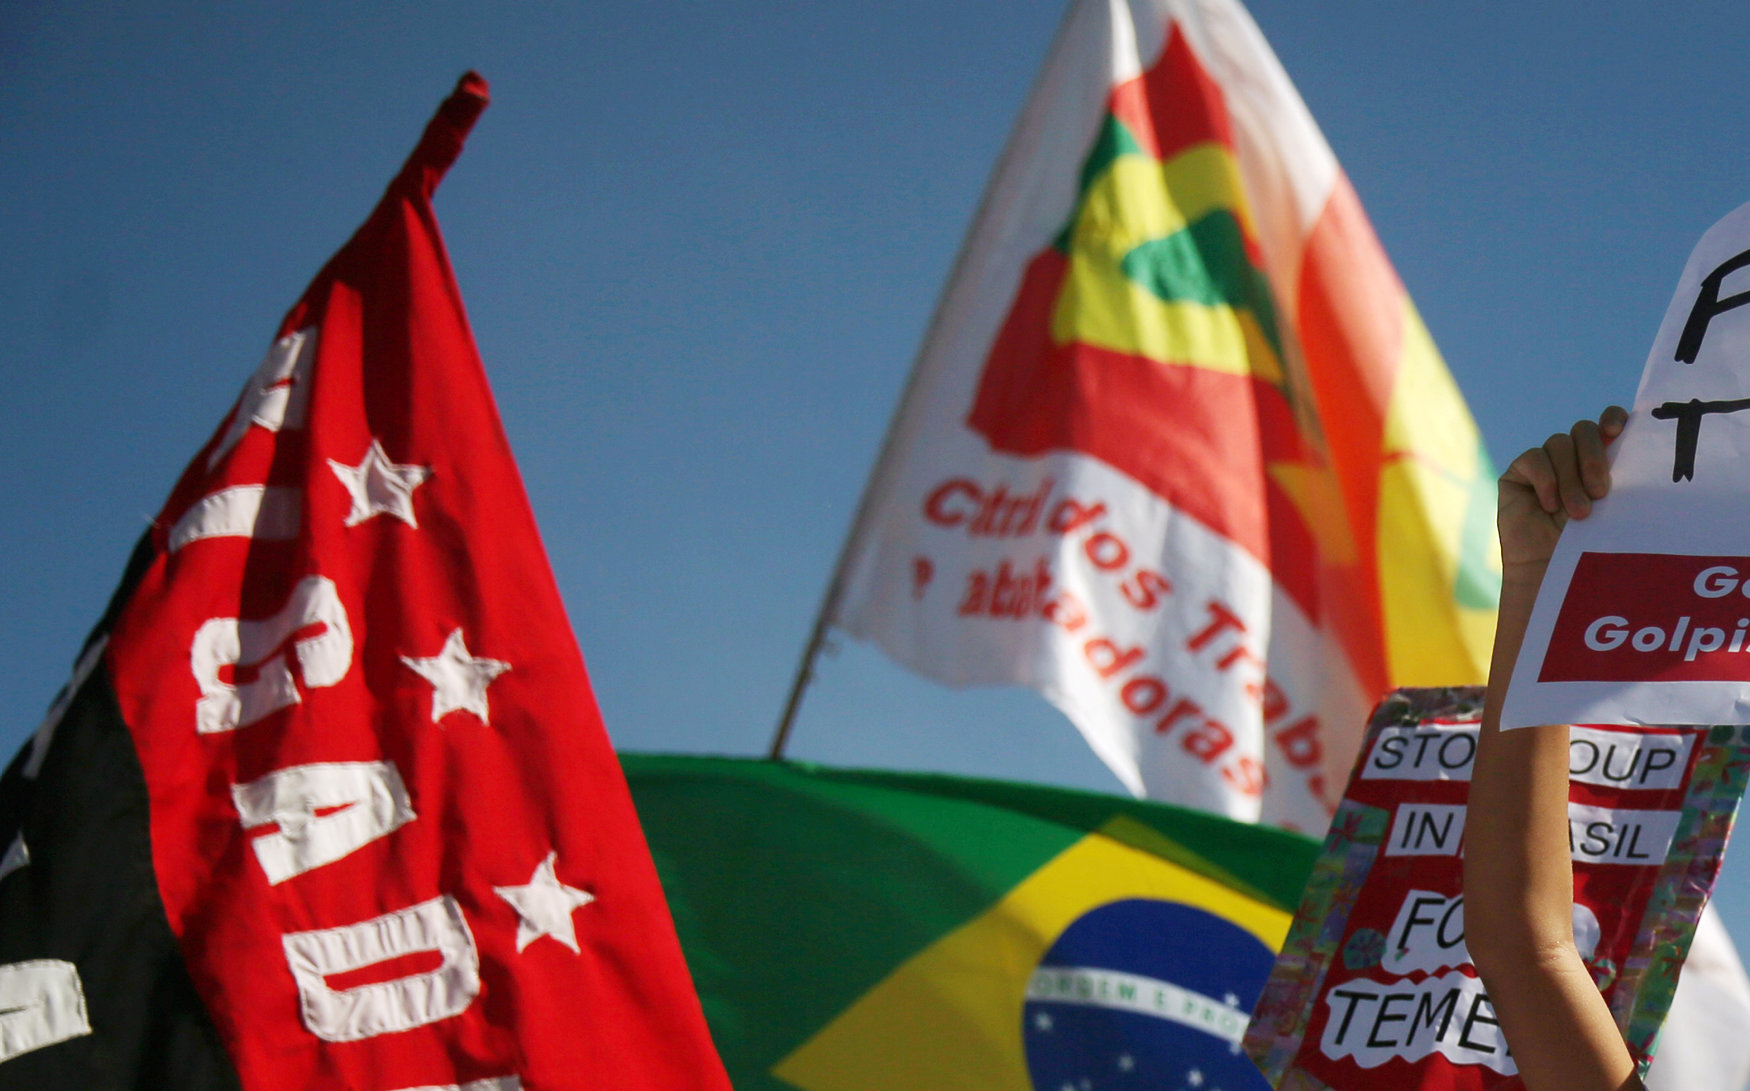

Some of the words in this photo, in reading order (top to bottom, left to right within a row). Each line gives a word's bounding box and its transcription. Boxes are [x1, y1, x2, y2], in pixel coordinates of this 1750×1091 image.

[1374, 732, 1477, 770] STO
[1569, 739, 1677, 784] OUP
[1401, 811, 1454, 849] IN
[1568, 819, 1650, 860] SIL
[1182, 998, 1239, 1035] PRO
[1334, 988, 1512, 1057] TEME
